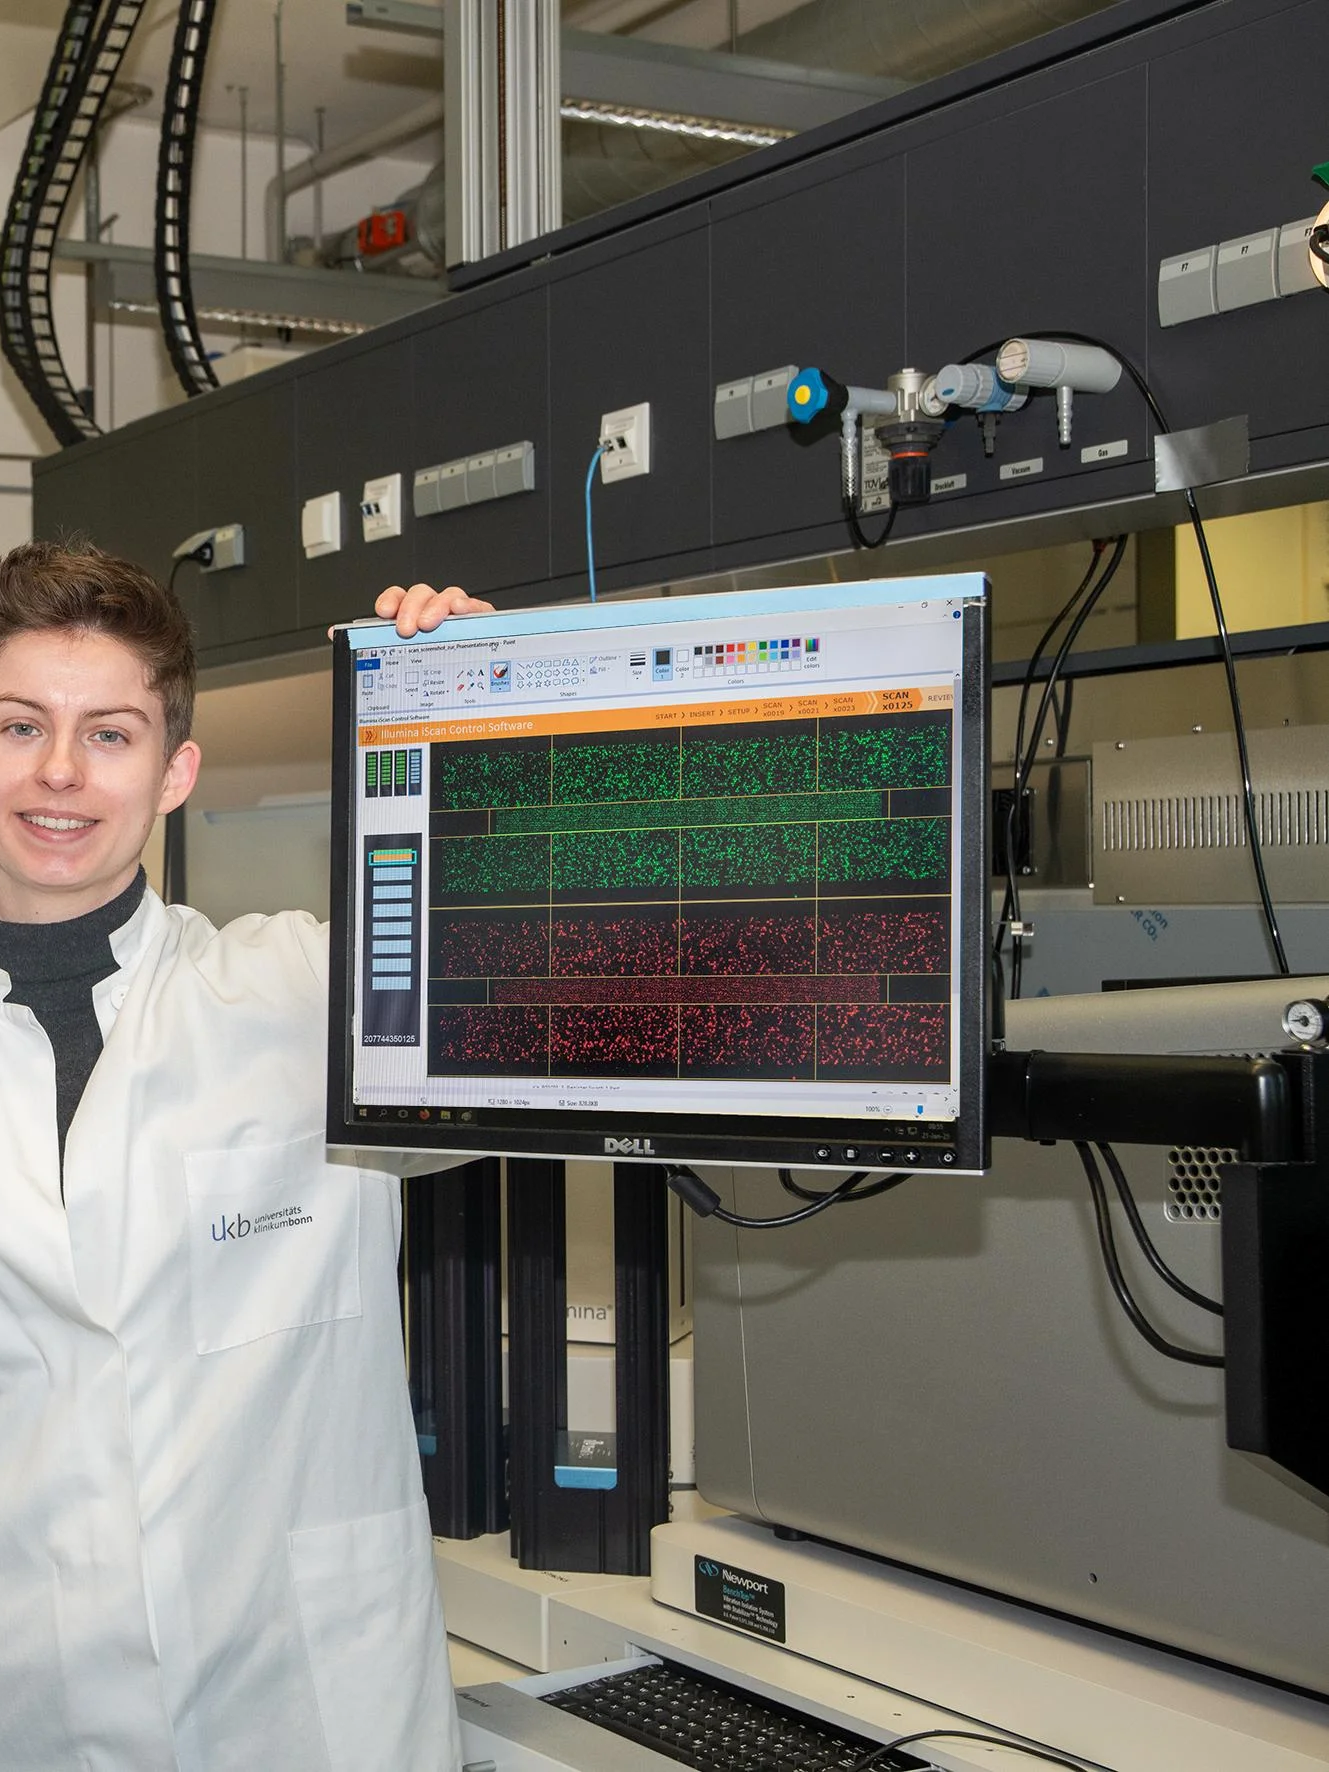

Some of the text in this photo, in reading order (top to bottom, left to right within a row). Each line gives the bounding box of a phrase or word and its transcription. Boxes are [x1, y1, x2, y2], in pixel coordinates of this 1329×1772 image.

[1241, 245, 1249, 255] F7
[1181, 262, 1189, 272] F7
[833, 697, 854, 705] SCAN
[882, 691, 910, 701] SCAN
[797, 699, 818, 707] SCAN
[882, 701, 913, 711] x0125
[655, 712, 678, 720] START
[689, 710, 716, 718] INSERT
[727, 708, 751, 716] SETUP
[381, 720, 533, 739] Illumina iScan Control Software
[363, 1034, 416, 1043] 207744350125
[604, 1137, 656, 1154] DELL
[254, 1205, 303, 1225] universitäts
[253, 1214, 313, 1235] klinikumbonn
[722, 1568, 769, 1595] Newport
